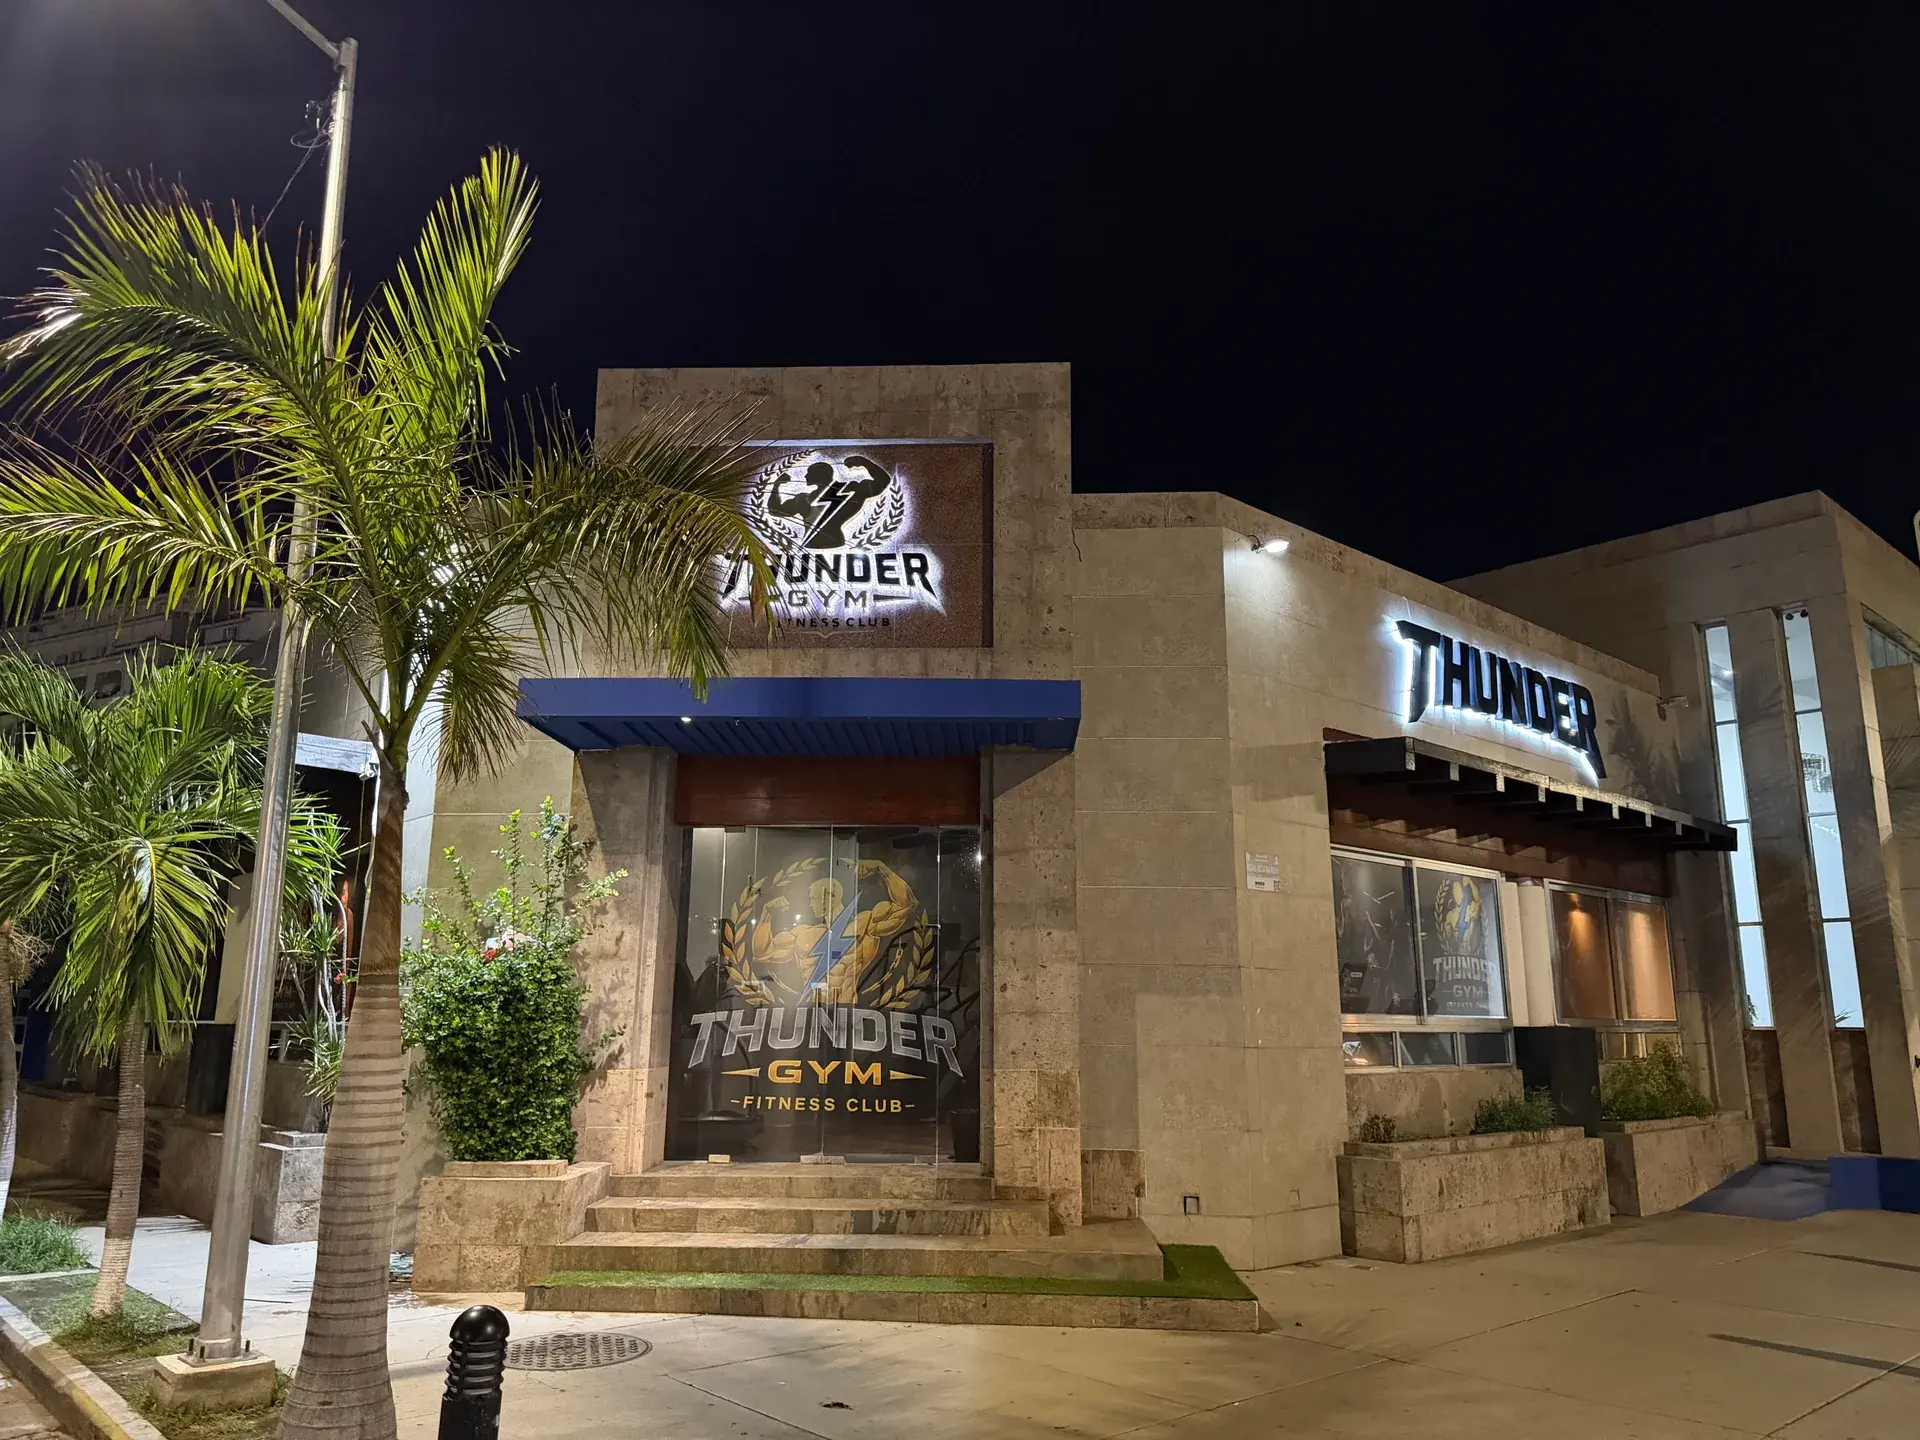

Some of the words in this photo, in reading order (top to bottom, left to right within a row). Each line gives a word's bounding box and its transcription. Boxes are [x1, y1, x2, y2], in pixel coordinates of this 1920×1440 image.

[787, 589, 868, 609] GYM
[846, 617, 891, 628] CLUB
[1395, 619, 1608, 779] THUNDER
[1452, 984, 1484, 999] GYM
[688, 1007, 965, 1078] THUNDER
[767, 1059, 882, 1086] GYM
